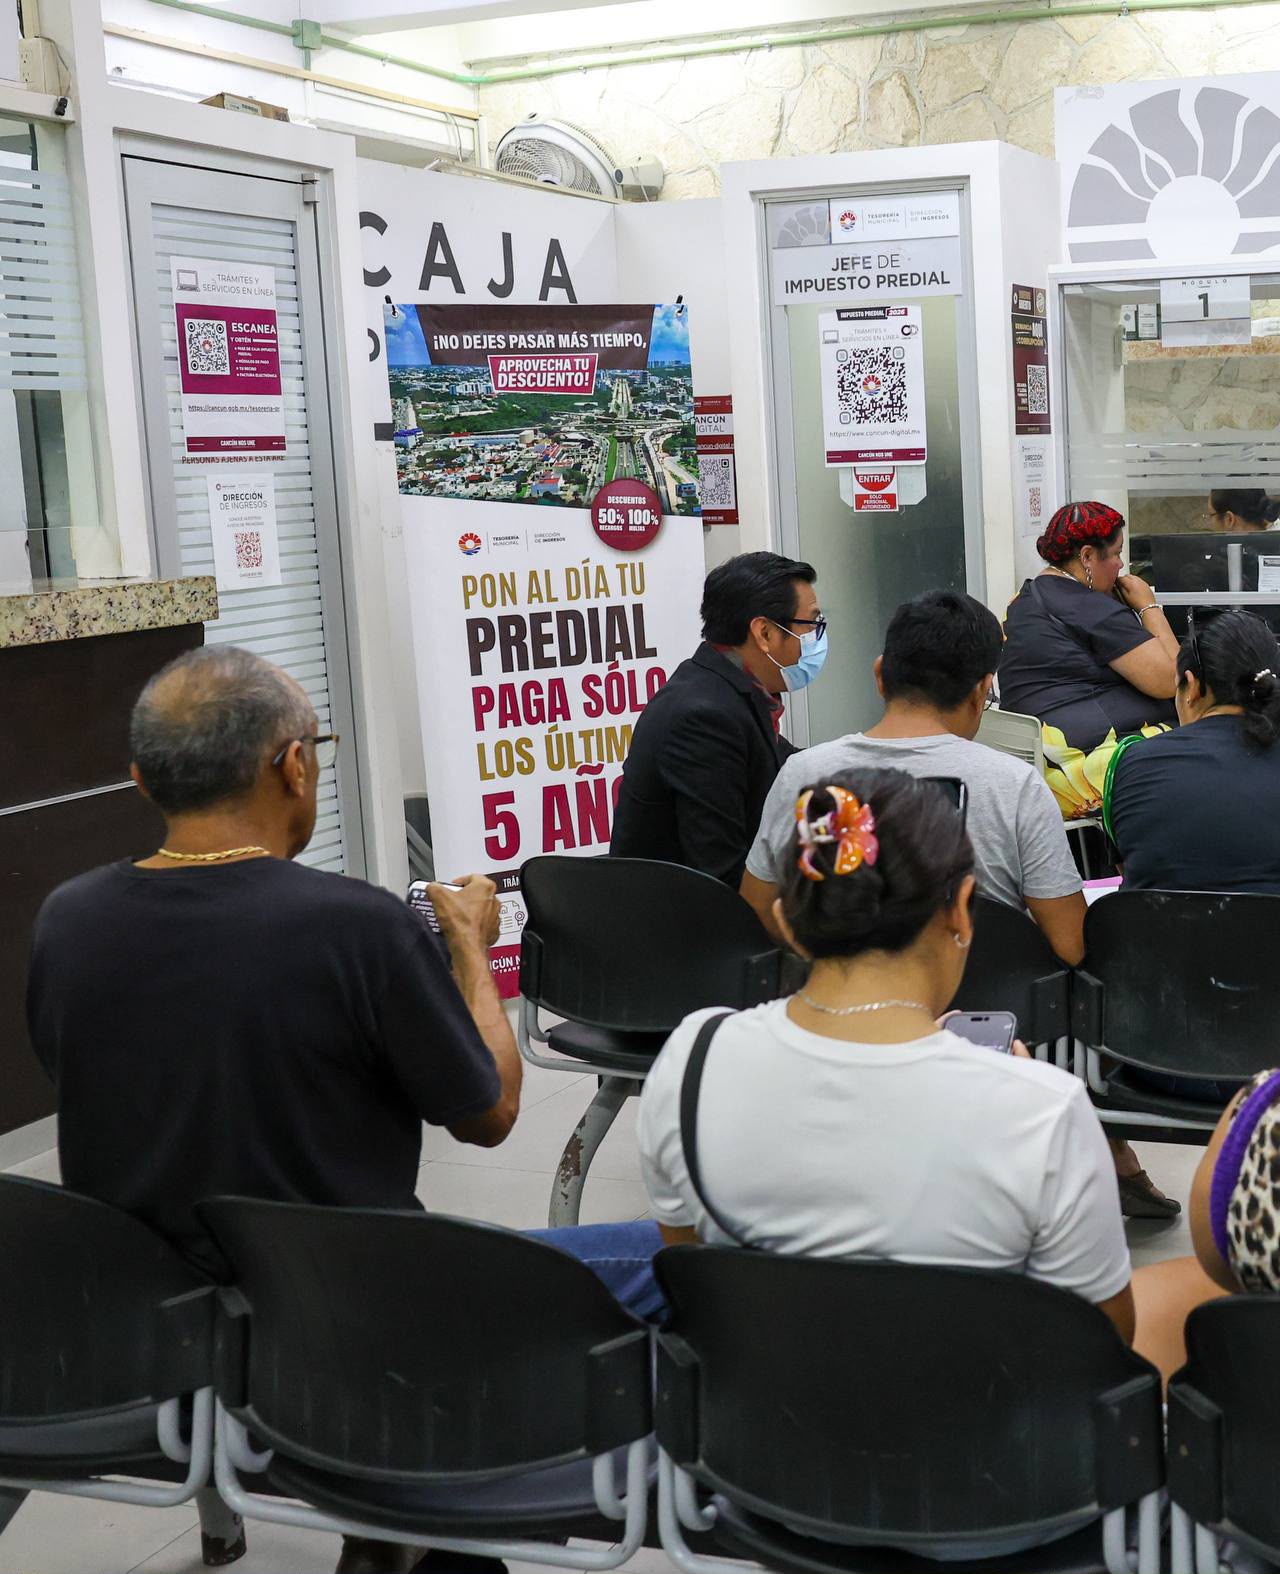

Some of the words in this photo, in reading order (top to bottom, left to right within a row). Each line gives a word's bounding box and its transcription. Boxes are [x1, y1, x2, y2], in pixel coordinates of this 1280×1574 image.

[359, 211, 578, 304] CAJA
[831, 255, 872, 271] JEFE
[878, 254, 900, 269] DE
[217, 274, 254, 284] TRÁMITES
[785, 276, 871, 294] IMPUESTO
[876, 271, 950, 288] PREDIAL
[202, 284, 241, 294] SERVICIOS
[242, 287, 252, 295] EN
[254, 287, 275, 297] LÍNEA
[865, 309, 885, 317] PREDIAL
[1198, 293, 1209, 318] 1
[231, 322, 277, 335] ESCANEA
[433, 335, 461, 350] ¡NO
[463, 334, 507, 349] DEJES
[509, 333, 555, 349] PASAR
[558, 331, 589, 348] MÁS
[590, 332, 648, 350] TIEMPO,
[498, 357, 569, 373] APROVECHA
[571, 355, 590, 371] TU
[497, 371, 589, 388] DESCUENTO!
[182, 455, 219, 464] PERSONAS
[221, 455, 247, 463] AJENAS
[858, 475, 891, 483] ENTRAR
[219, 502, 230, 510] DE
[231, 500, 268, 510] INGRESOS
[222, 492, 263, 501] DIRECCIÓN
[607, 496, 647, 505] DESCUENTOS
[462, 571, 518, 610] PON
[527, 568, 558, 605] AL
[565, 558, 611, 601] DÍA
[615, 562, 646, 597] TU
[466, 603, 658, 677] PREDIAL
[472, 677, 572, 732] PAGA
[581, 661, 667, 718] SÓLO
[476, 736, 536, 781] LOS
[482, 791, 521, 861] 5
